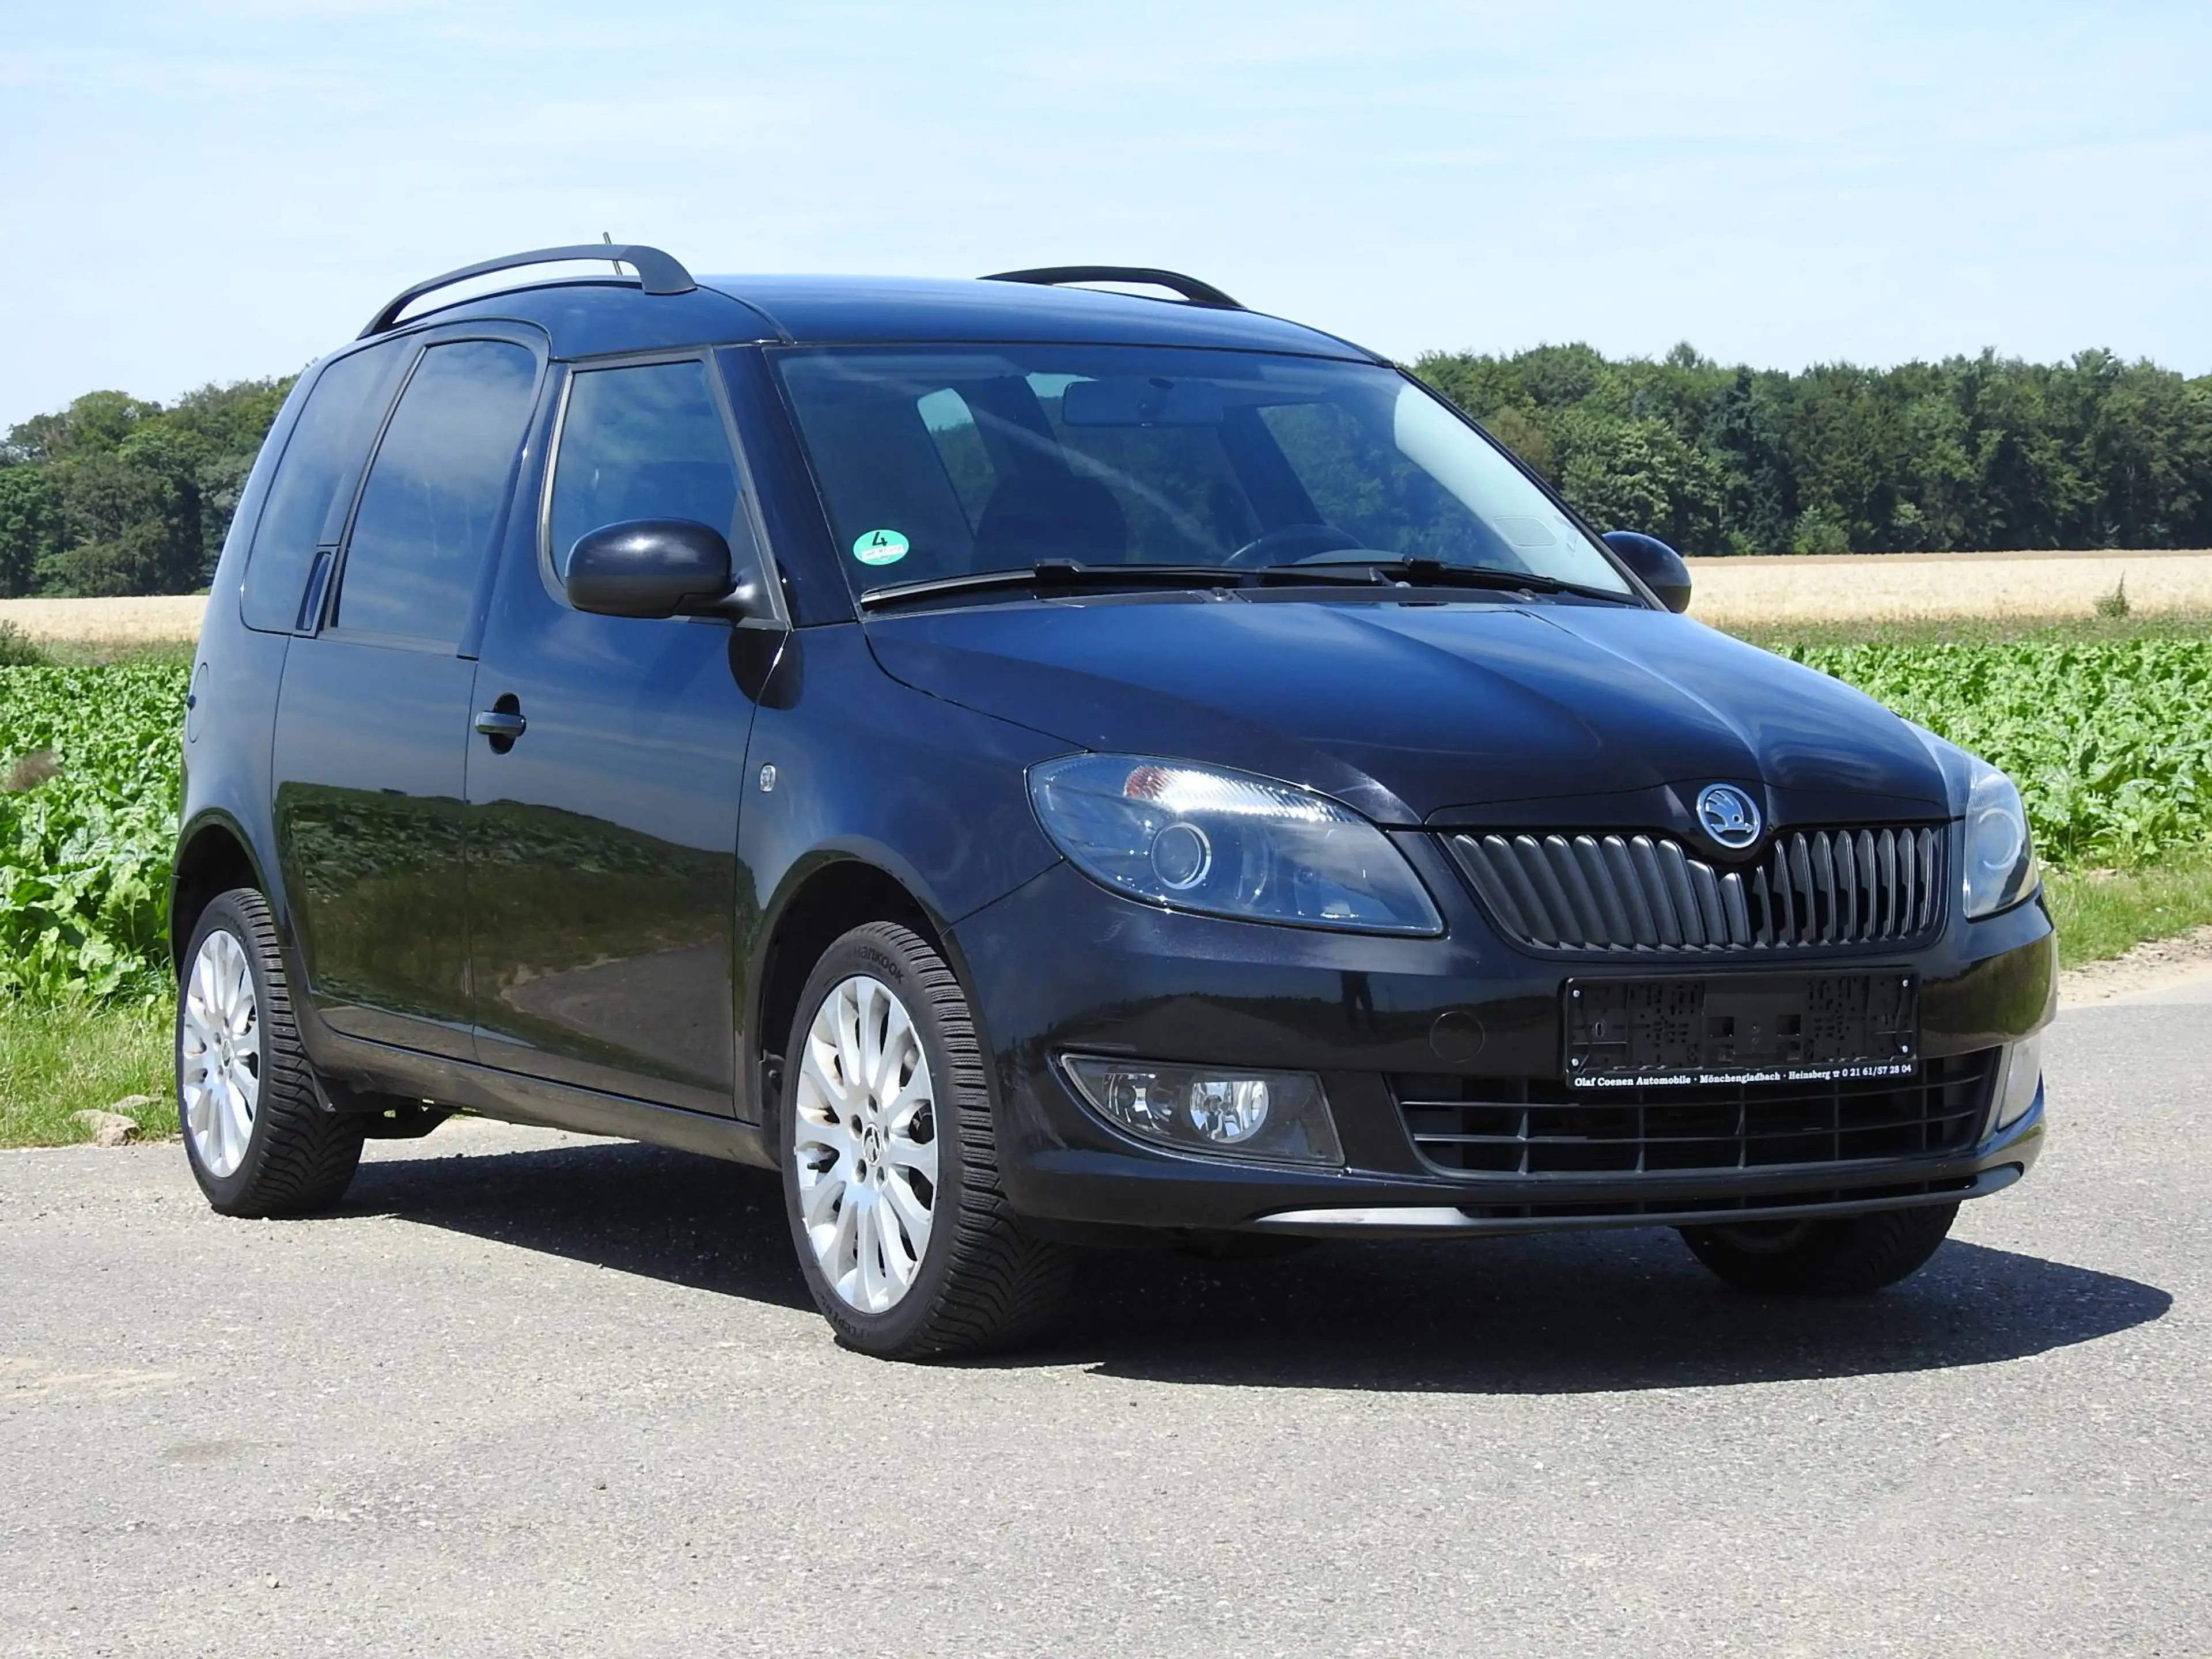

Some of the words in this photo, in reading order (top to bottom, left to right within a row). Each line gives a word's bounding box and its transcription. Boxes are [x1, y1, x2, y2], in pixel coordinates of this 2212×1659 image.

[872, 532, 888, 546] 4
[1574, 1077, 1596, 1086] Olaf
[1597, 1077, 1634, 1086] Coenen
[1636, 1075, 1691, 1085] Automobile
[1700, 1072, 1780, 1084] Mönchengladbach
[1789, 1070, 1830, 1080] Heinsberg
[1842, 1069, 1848, 1077] 0
[1850, 1068, 1860, 1076] 21
[1863, 1066, 1887, 1076] 61/57
[1902, 1065, 1911, 1073] 04
